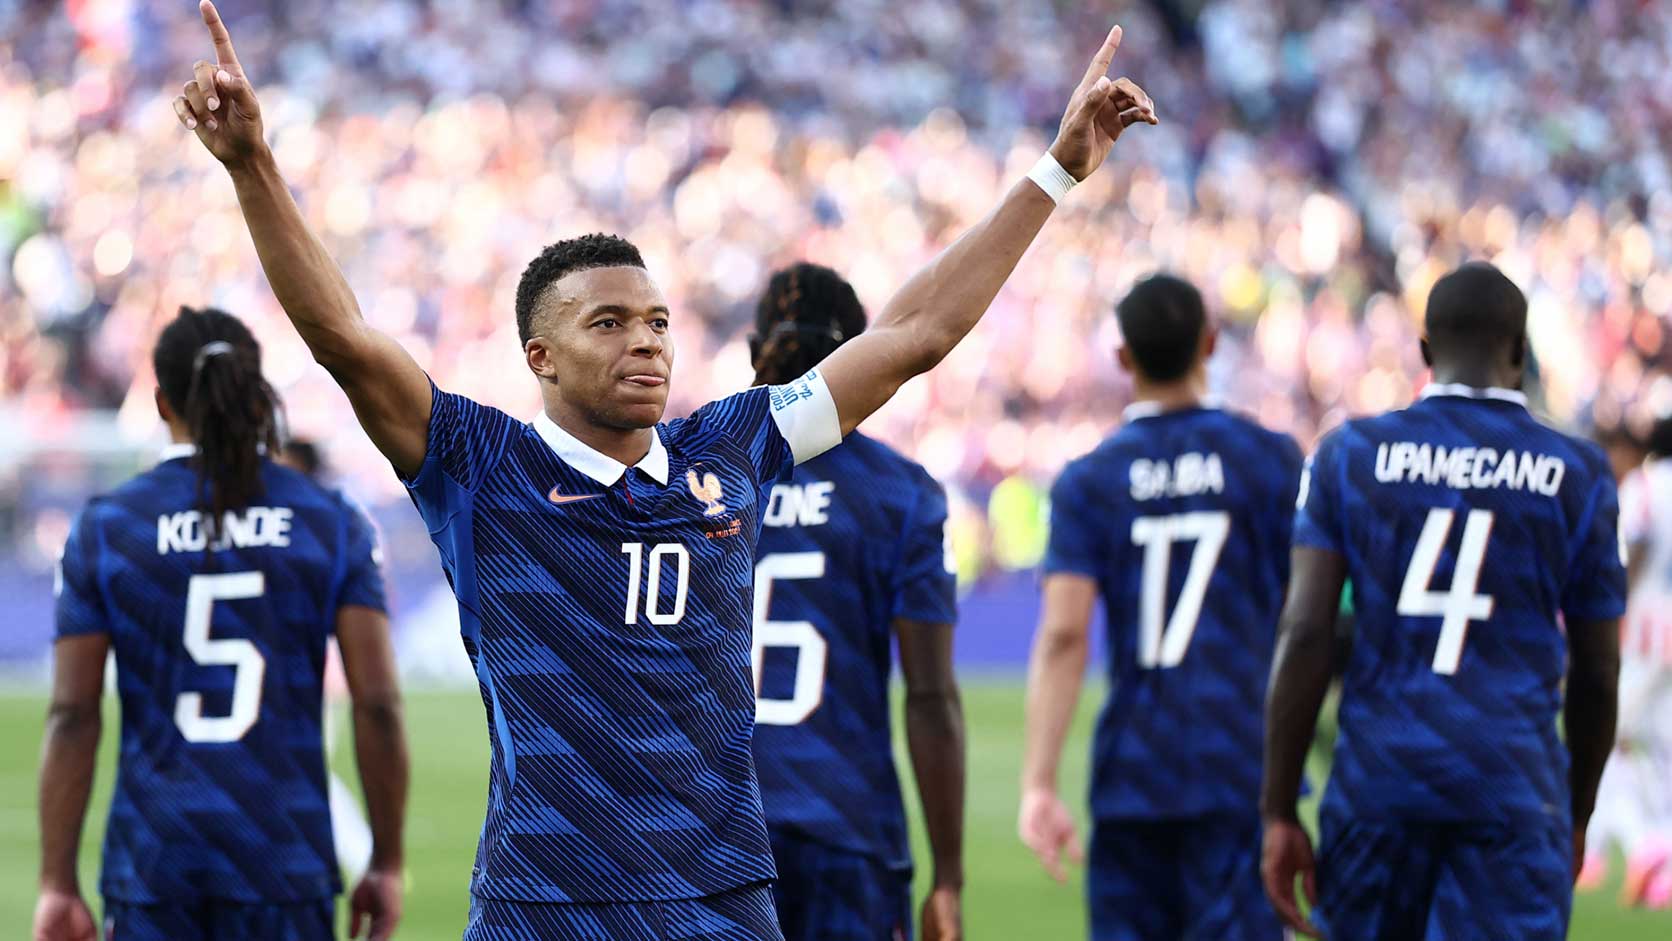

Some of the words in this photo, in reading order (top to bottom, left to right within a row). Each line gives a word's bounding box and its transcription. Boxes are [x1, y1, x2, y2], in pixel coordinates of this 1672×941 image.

[763, 481, 835, 527] ONE
[1375, 442, 1565, 497] UPAMECANO
[175, 571, 265, 743] 5
[621, 542, 690, 625] 10
[751, 552, 827, 725] 6
[1131, 511, 1230, 668] 17
[1397, 507, 1494, 675] 4
